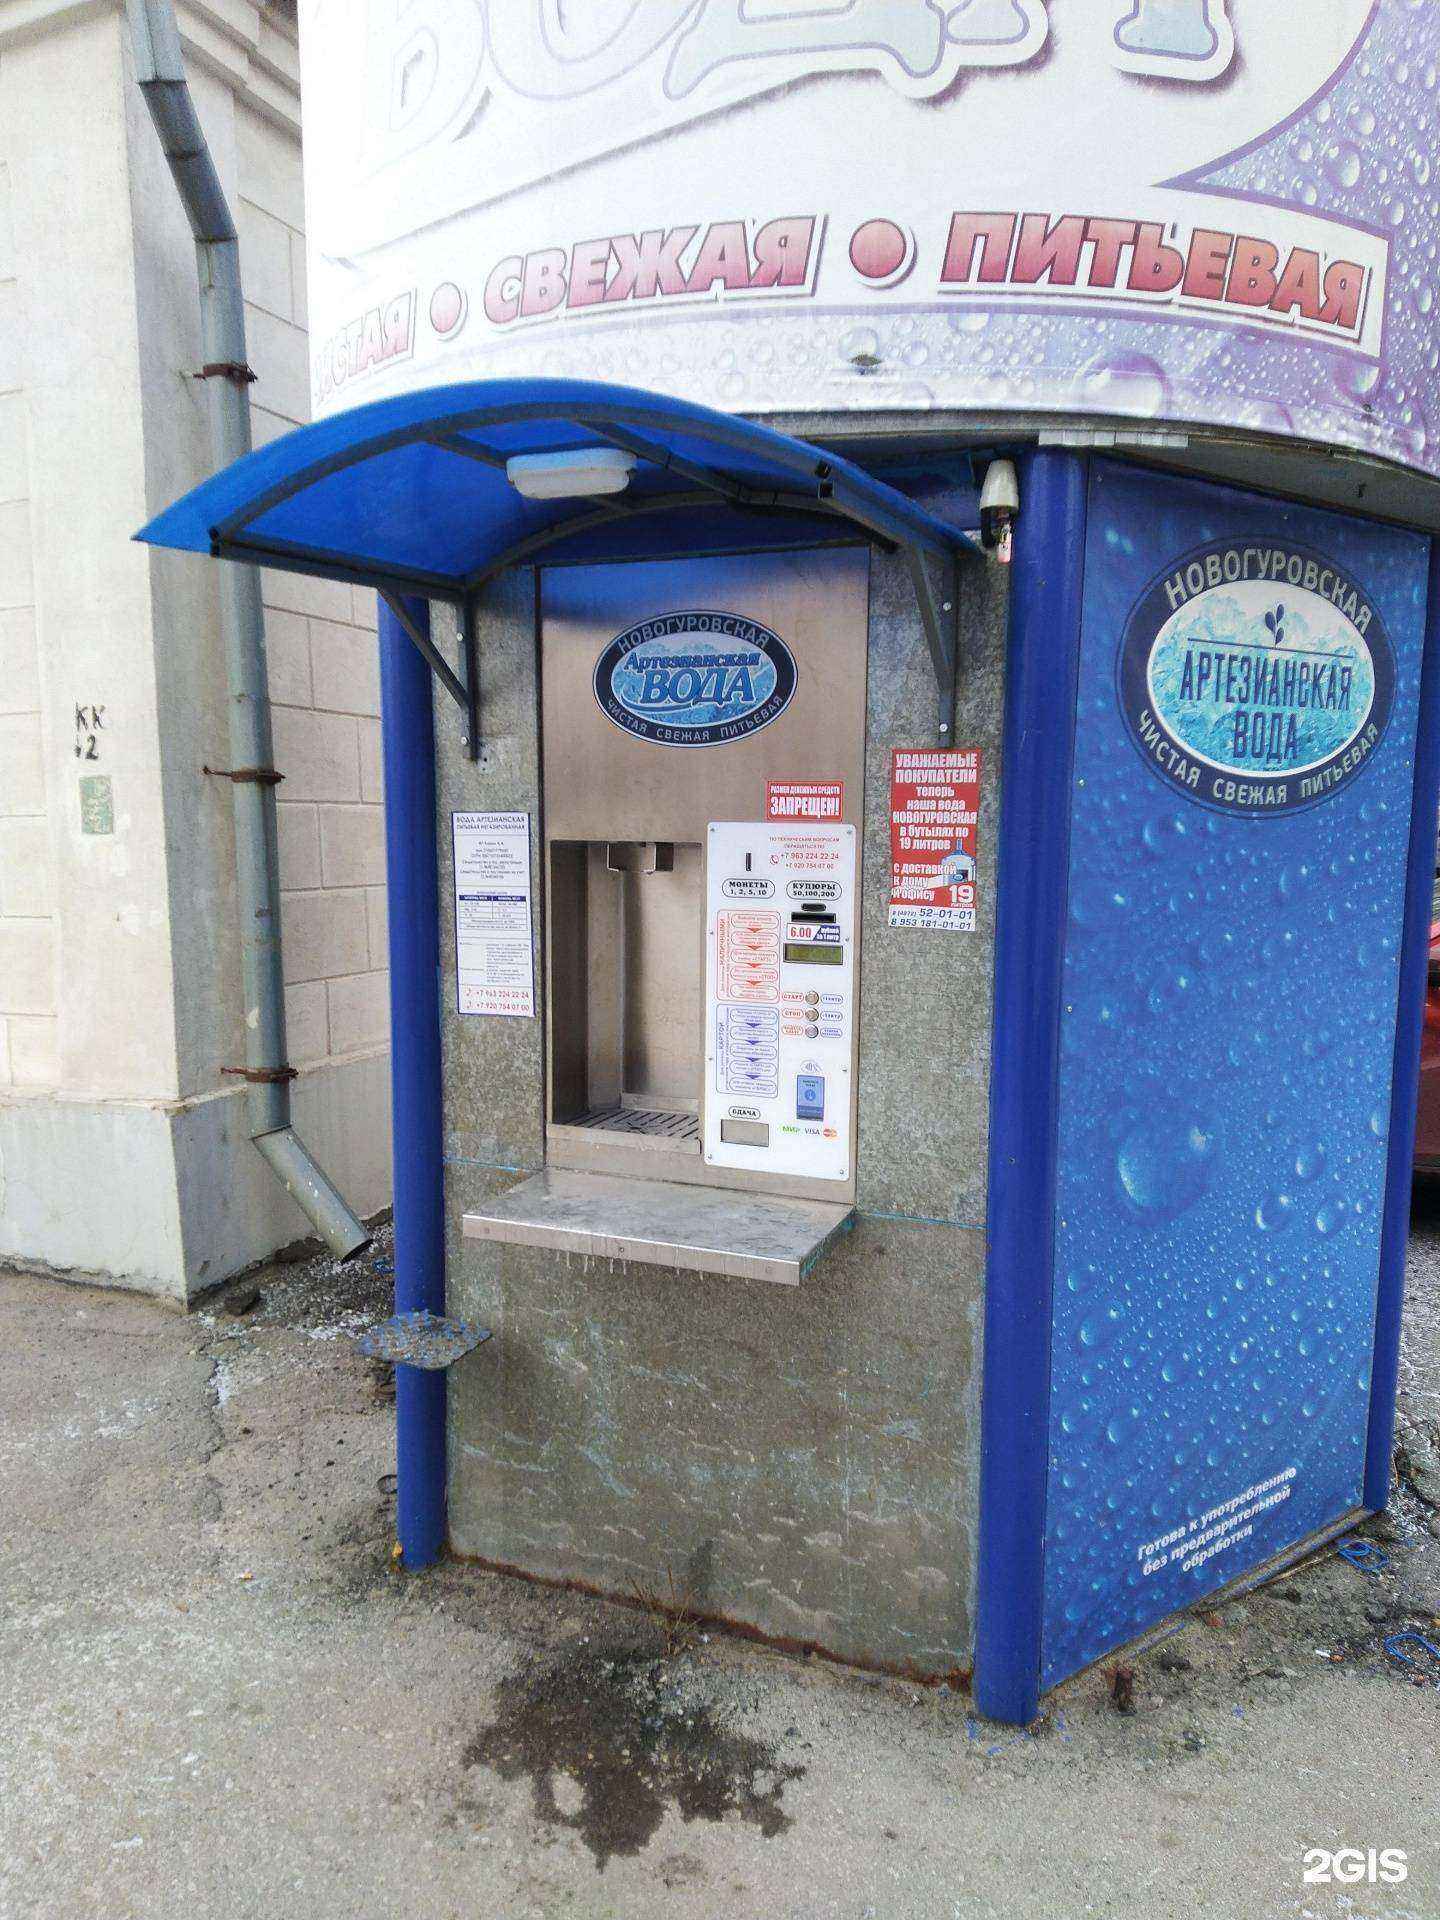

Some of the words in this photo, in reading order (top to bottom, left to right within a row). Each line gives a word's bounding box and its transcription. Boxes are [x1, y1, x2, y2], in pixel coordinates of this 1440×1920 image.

[484, 214, 820, 325] СВЕЖАЯ
[940, 210, 1365, 330] ПИТЬЕВАЯ
[1164, 549, 1373, 634] НОВОГУРОВСКАЯ
[617, 616, 770, 653] НОВОГУРОВСКАЯ
[639, 666, 757, 707] ВОДА
[1180, 650, 1352, 711] АРТЕЗИАНСКАЯ
[608, 700, 648, 733] ЧИСТАЯ
[656, 729, 710, 741] СВЕЖАЯ
[720, 695, 785, 738] ПИТЬЕВАЯ
[1232, 710, 1299, 764] ВОДА
[895, 753, 978, 768] УВАЖАЕМЫЕ
[1138, 709, 1201, 788] ЧИСТАЯ
[1212, 778, 1288, 806] СВЕЖАЯ
[1300, 722, 1379, 798] ПИТЬЕВАЯ
[895, 769, 977, 783] ПОКУПАТЕЛИ
[916, 786, 955, 797] теперь
[770, 796, 840, 818] ЗАПРЕЩЕН!
[907, 800, 937, 810] наша
[938, 800, 966, 811] вода
[892, 811, 978, 824] НОВОГУРОВСКАЯ
[955, 827, 969, 837] по
[900, 837, 911, 849] 19
[912, 839, 951, 850] литров
[792, 882, 836, 890] КУПЮРЫ
[949, 885, 974, 904] 19
[919, 908, 973, 919] 52-01-01
[790, 926, 812, 938] 6.00
[900, 918, 917, 926] 953
[921, 920, 972, 929] 181-01-01
[732, 1108, 757, 1118] СДАЧА
[804, 1127, 821, 1136] VISA
[1137, 1525, 1187, 1561] Готова
[1200, 1466, 1297, 1530] употреблению
[1142, 1554, 1168, 1577] без
[1171, 1484, 1293, 1561] предварительной
[1181, 1523, 1254, 1573] обработки
